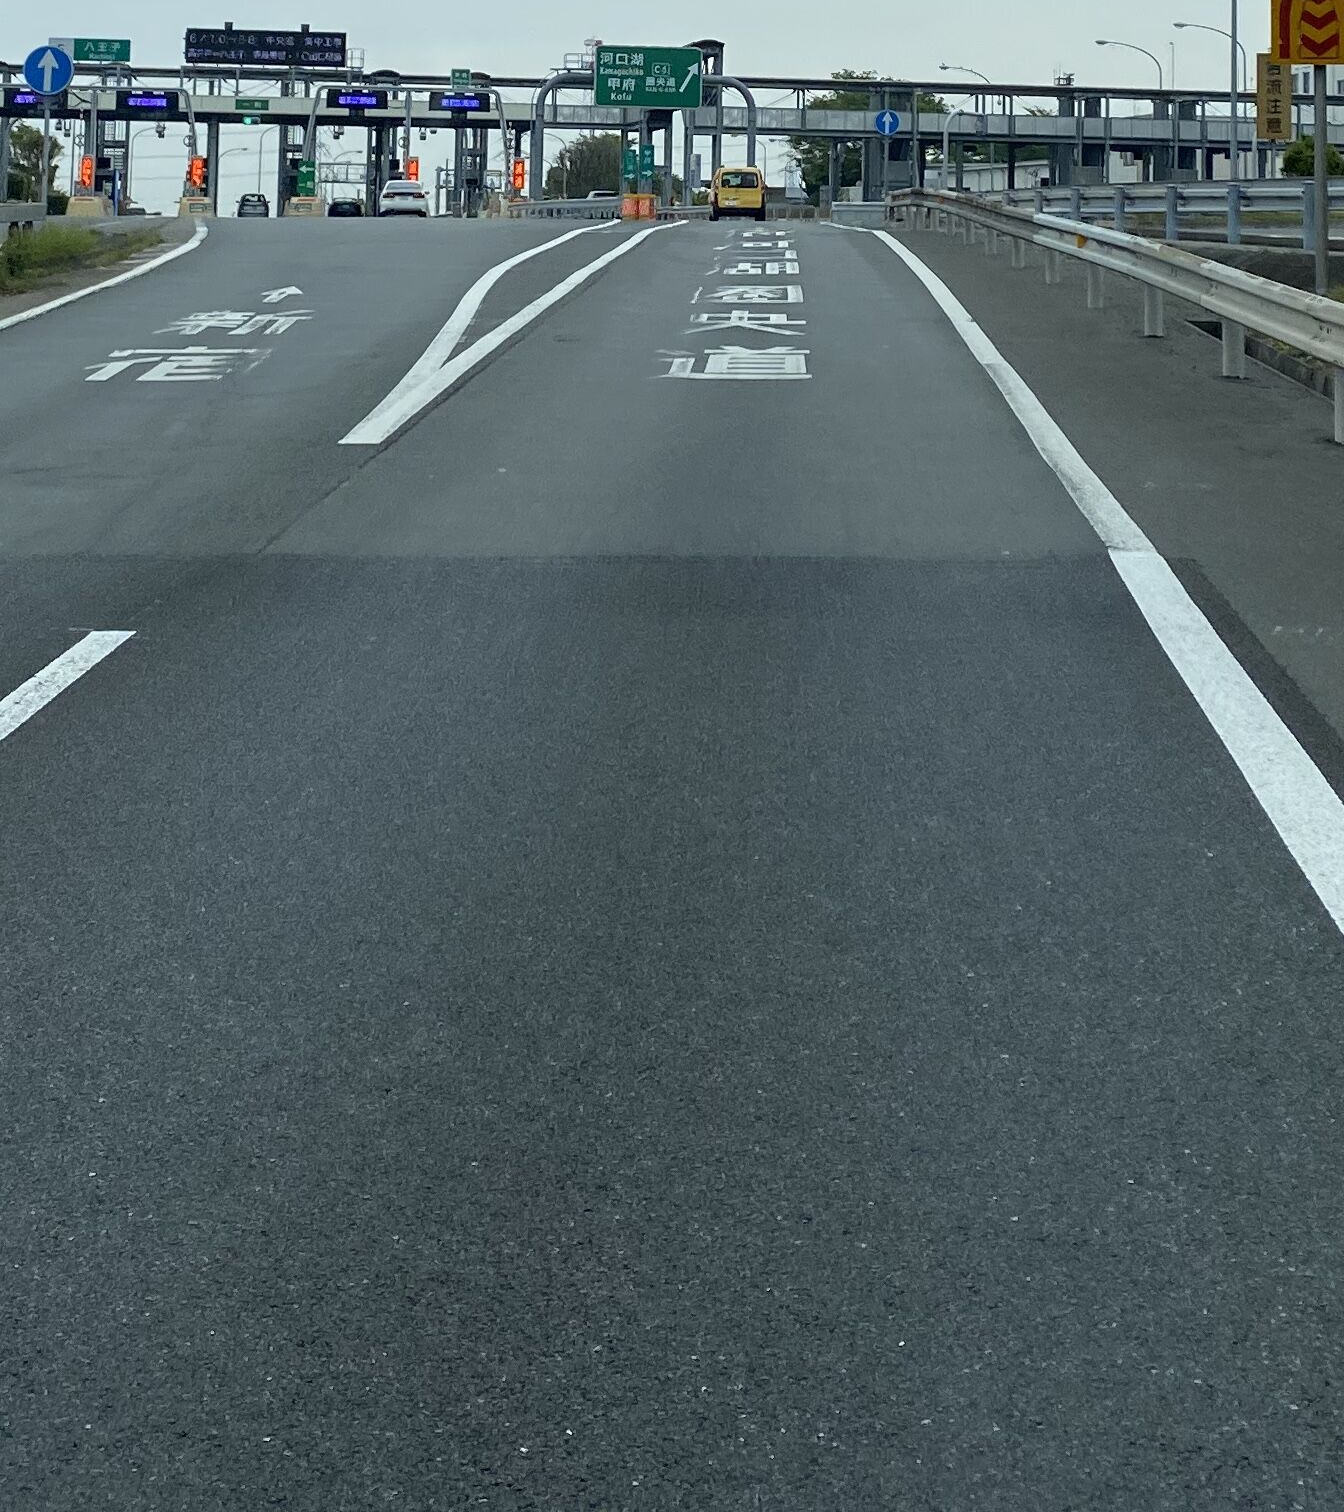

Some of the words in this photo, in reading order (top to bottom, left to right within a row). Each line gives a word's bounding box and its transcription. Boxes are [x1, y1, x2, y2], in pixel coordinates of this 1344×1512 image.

[600, 52, 644, 66] 河口湖
[607, 77, 636, 92] 甲府
[610, 92, 632, 101] Kofu
